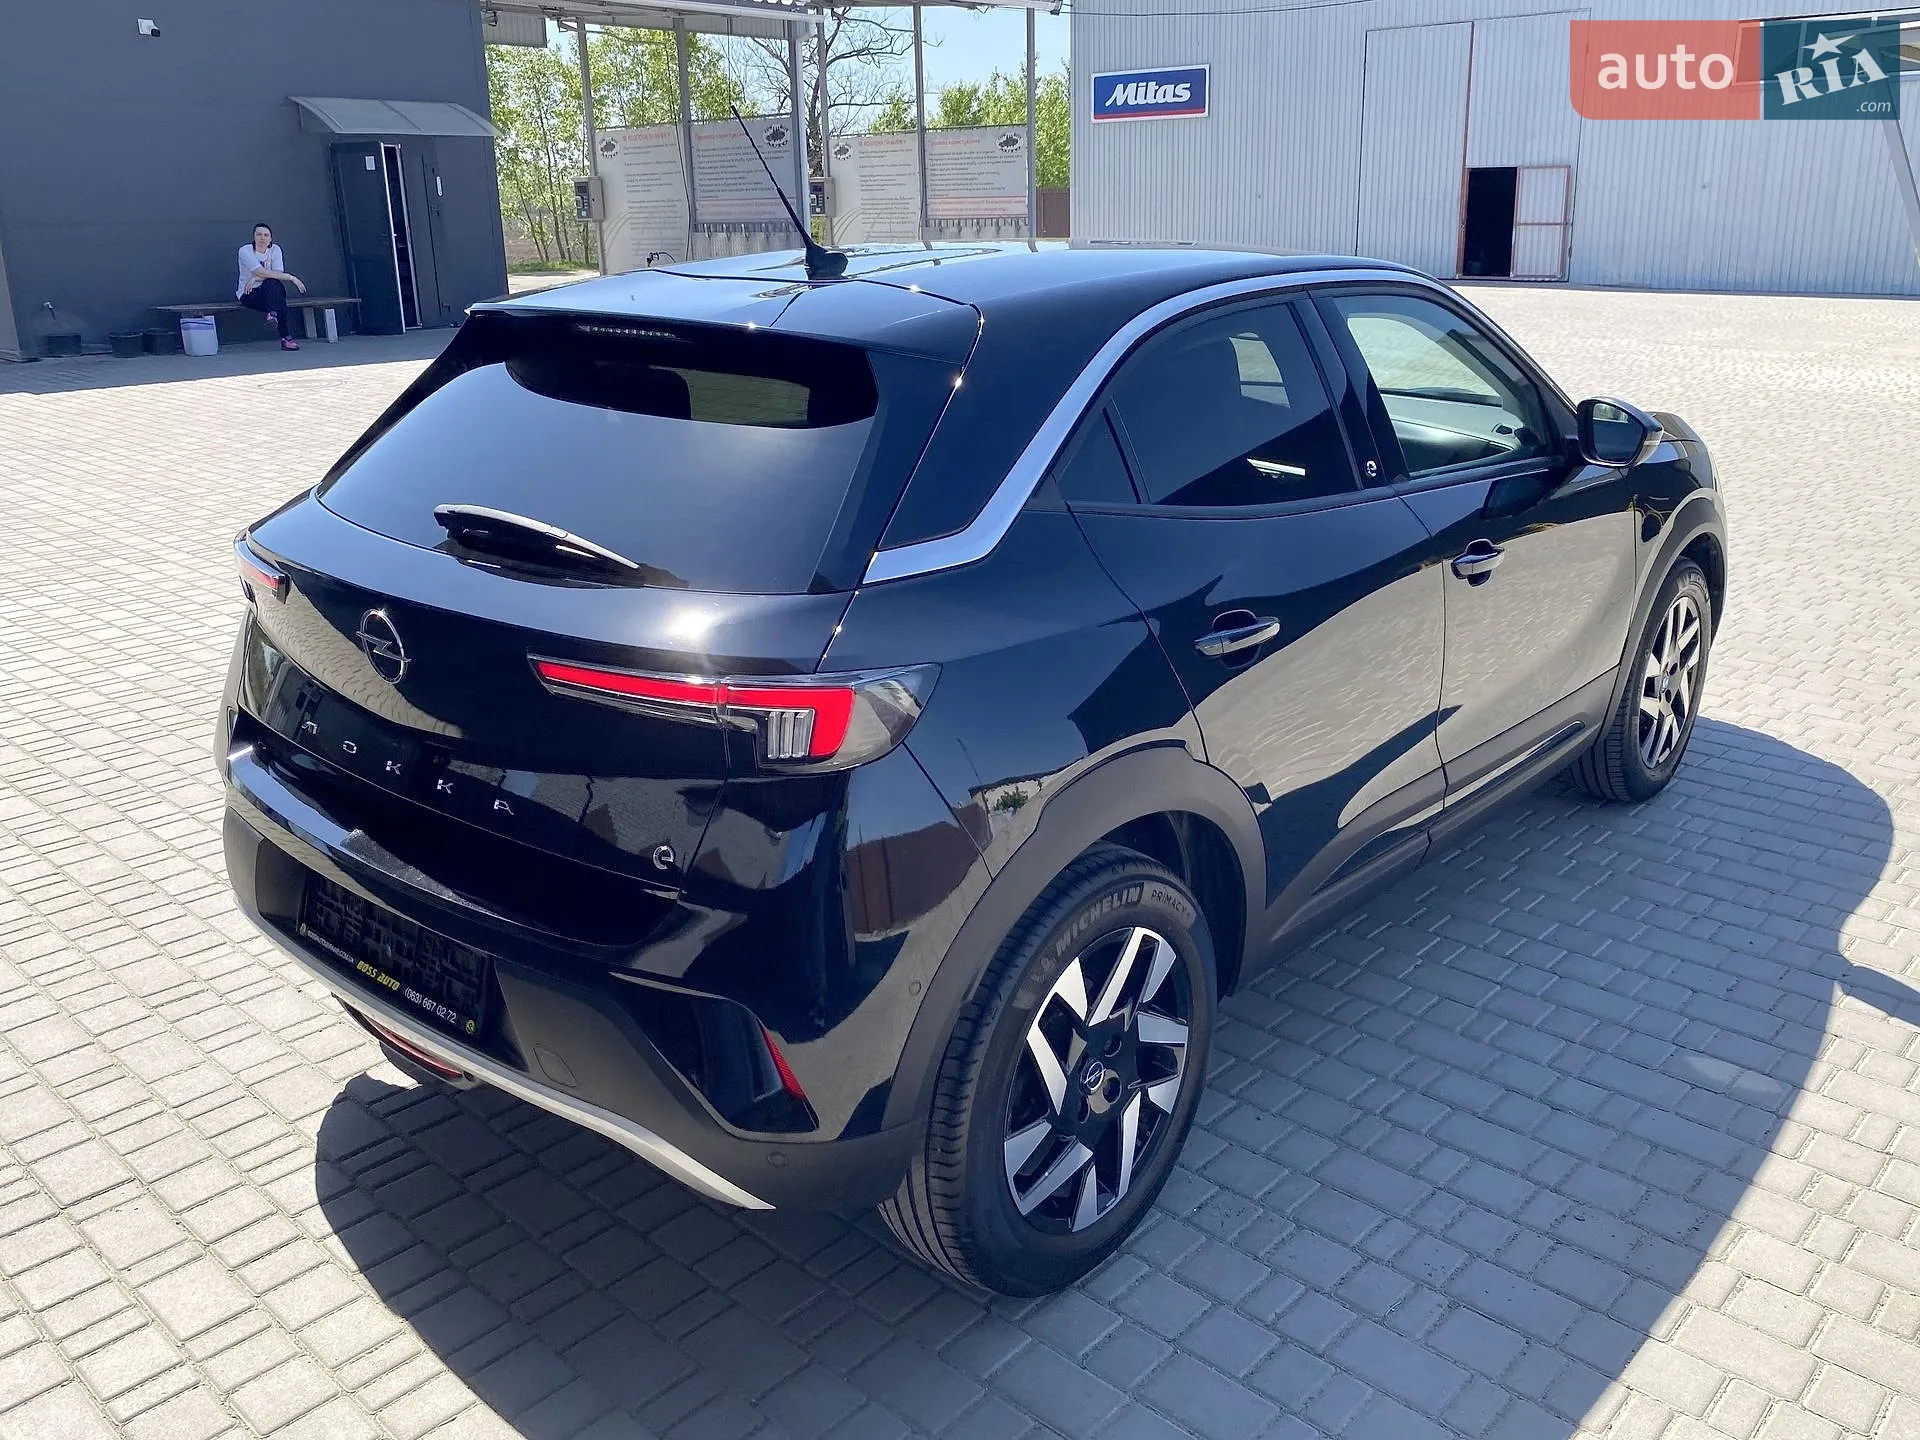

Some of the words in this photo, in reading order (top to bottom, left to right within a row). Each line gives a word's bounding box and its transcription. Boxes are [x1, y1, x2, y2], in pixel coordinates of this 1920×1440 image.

[1105, 81, 1191, 107] Mitas
[1056, 886, 1141, 957] MICHELIN
[1151, 889, 1188, 914] PRIMACY
[356, 960, 377, 978] BOSS
[377, 973, 400, 991] AUTO
[404, 987, 422, 1004] (063)
[422, 998, 437, 1012] 667
[436, 1005, 447, 1018] 02
[447, 1010, 457, 1023] 72
